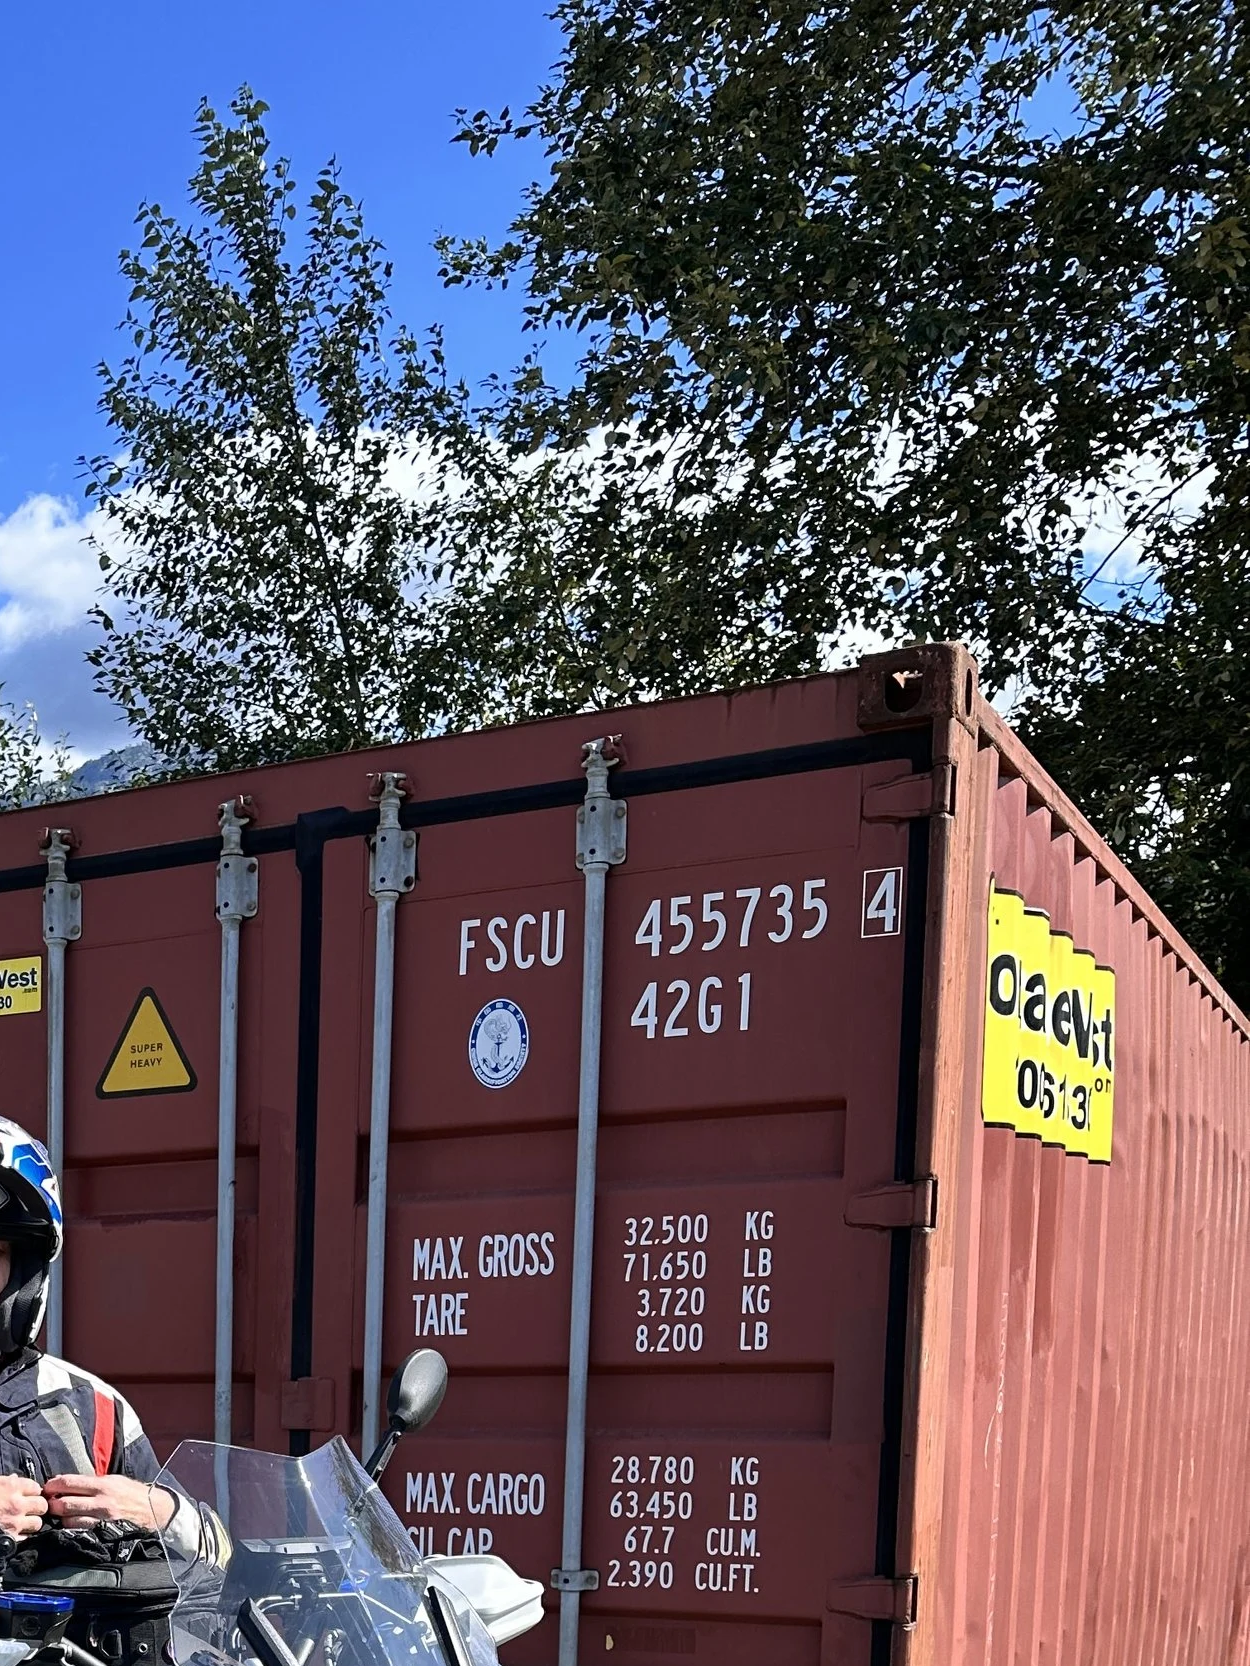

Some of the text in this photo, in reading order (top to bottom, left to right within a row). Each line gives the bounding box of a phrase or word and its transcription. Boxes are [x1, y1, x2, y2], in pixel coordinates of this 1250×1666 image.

[459, 871, 898, 975] FSCU 455735 4
[631, 973, 750, 1038] 42G1
[130, 1042, 163, 1054] SUPER
[130, 1057, 162, 1068] HEAVY
[746, 1211, 773, 1240] KG
[413, 1232, 554, 1280] MAX. GROSS
[744, 1248, 771, 1277] LB
[742, 1285, 770, 1314] KG
[413, 1293, 468, 1336] TARE
[740, 1322, 767, 1350] LB
[731, 1457, 758, 1485] KG
[406, 1472, 544, 1515] MAX. CARGO
[729, 1493, 756, 1521] LB
[625, 1526, 674, 1553] 67.7
